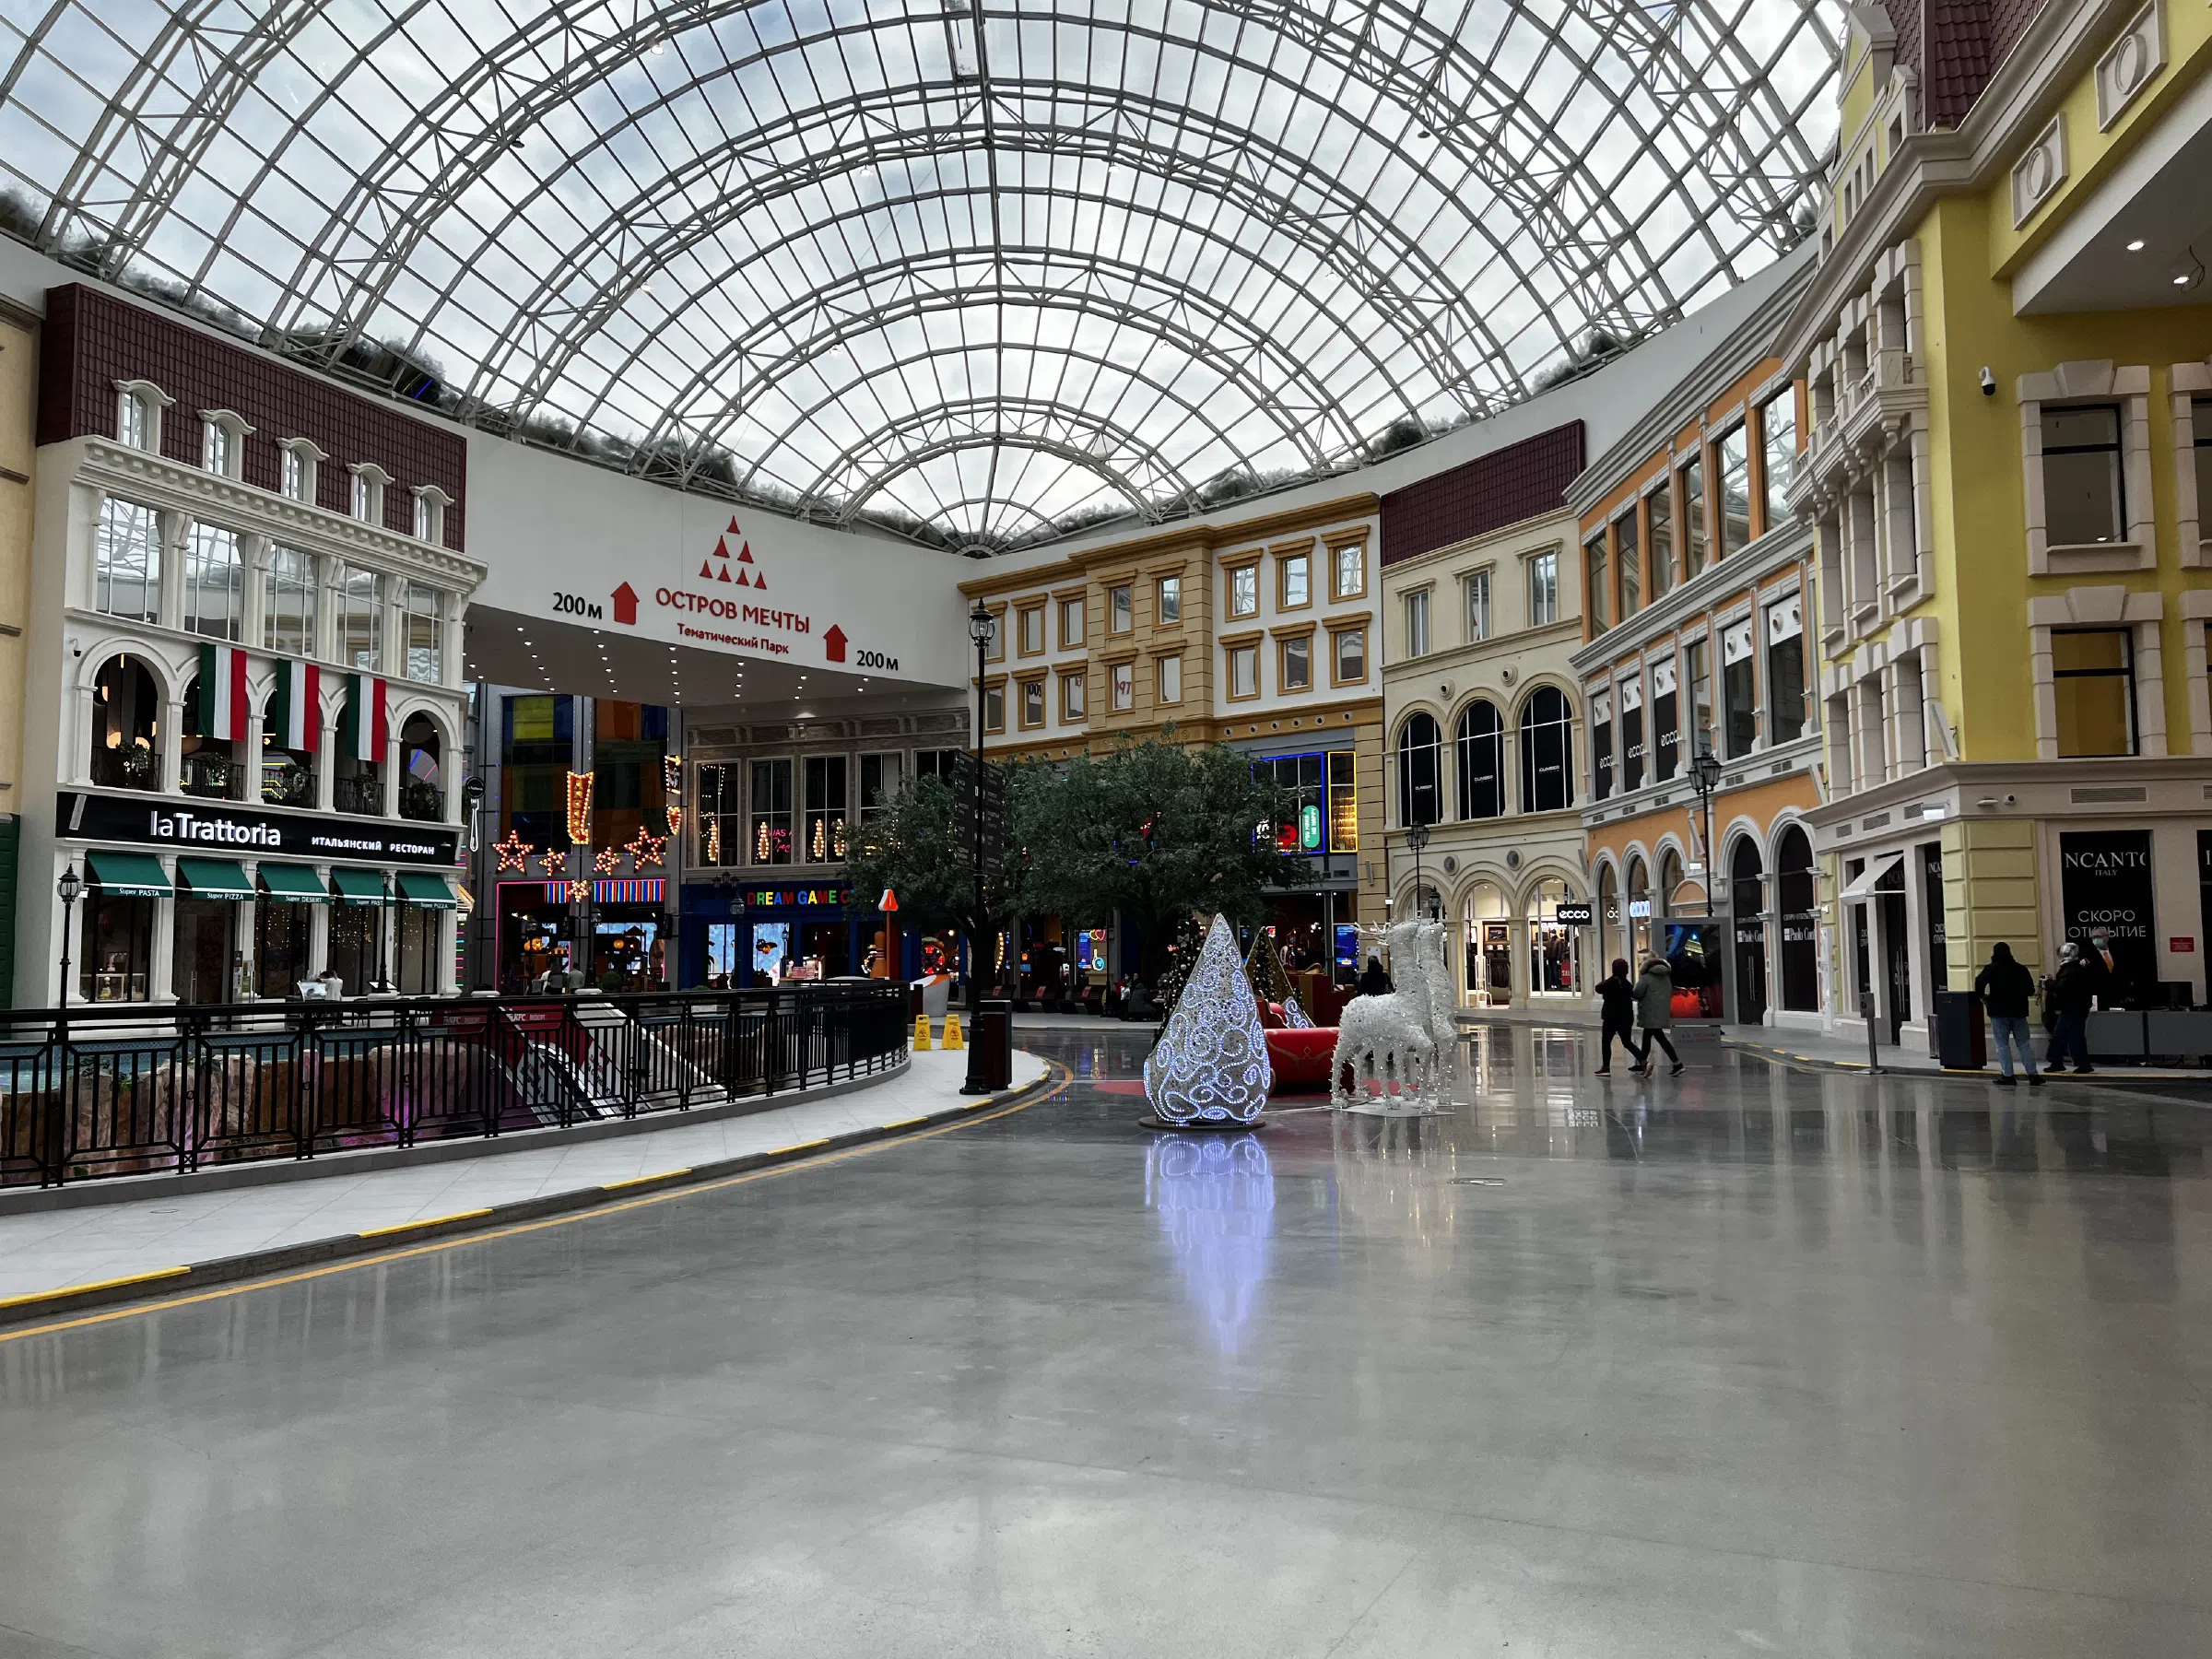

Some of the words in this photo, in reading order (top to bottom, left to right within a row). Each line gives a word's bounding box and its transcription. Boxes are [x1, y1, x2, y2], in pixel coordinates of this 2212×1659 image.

[655, 587, 737, 619] ОСТРОВ
[742, 604, 810, 634] МЕЧТЫ
[677, 622, 759, 649] Тематический
[760, 639, 790, 654] Парк
[173, 812, 281, 846] Trattoria
[312, 836, 382, 852] ИТАЛЬЯНСКИЙ
[389, 842, 435, 855] РЕСТОРАН
[2065, 852, 2147, 868] NCANT
[119, 888, 136, 896] Super
[138, 888, 160, 897] PASTA
[206, 892, 223, 900] Super
[747, 891, 794, 906] DREAM
[797, 890, 838, 905] GAME
[1559, 910, 1590, 919] ecco
[2077, 910, 2136, 923] СКОРО
[2067, 925, 2147, 938] ОТКЫТИЕ
